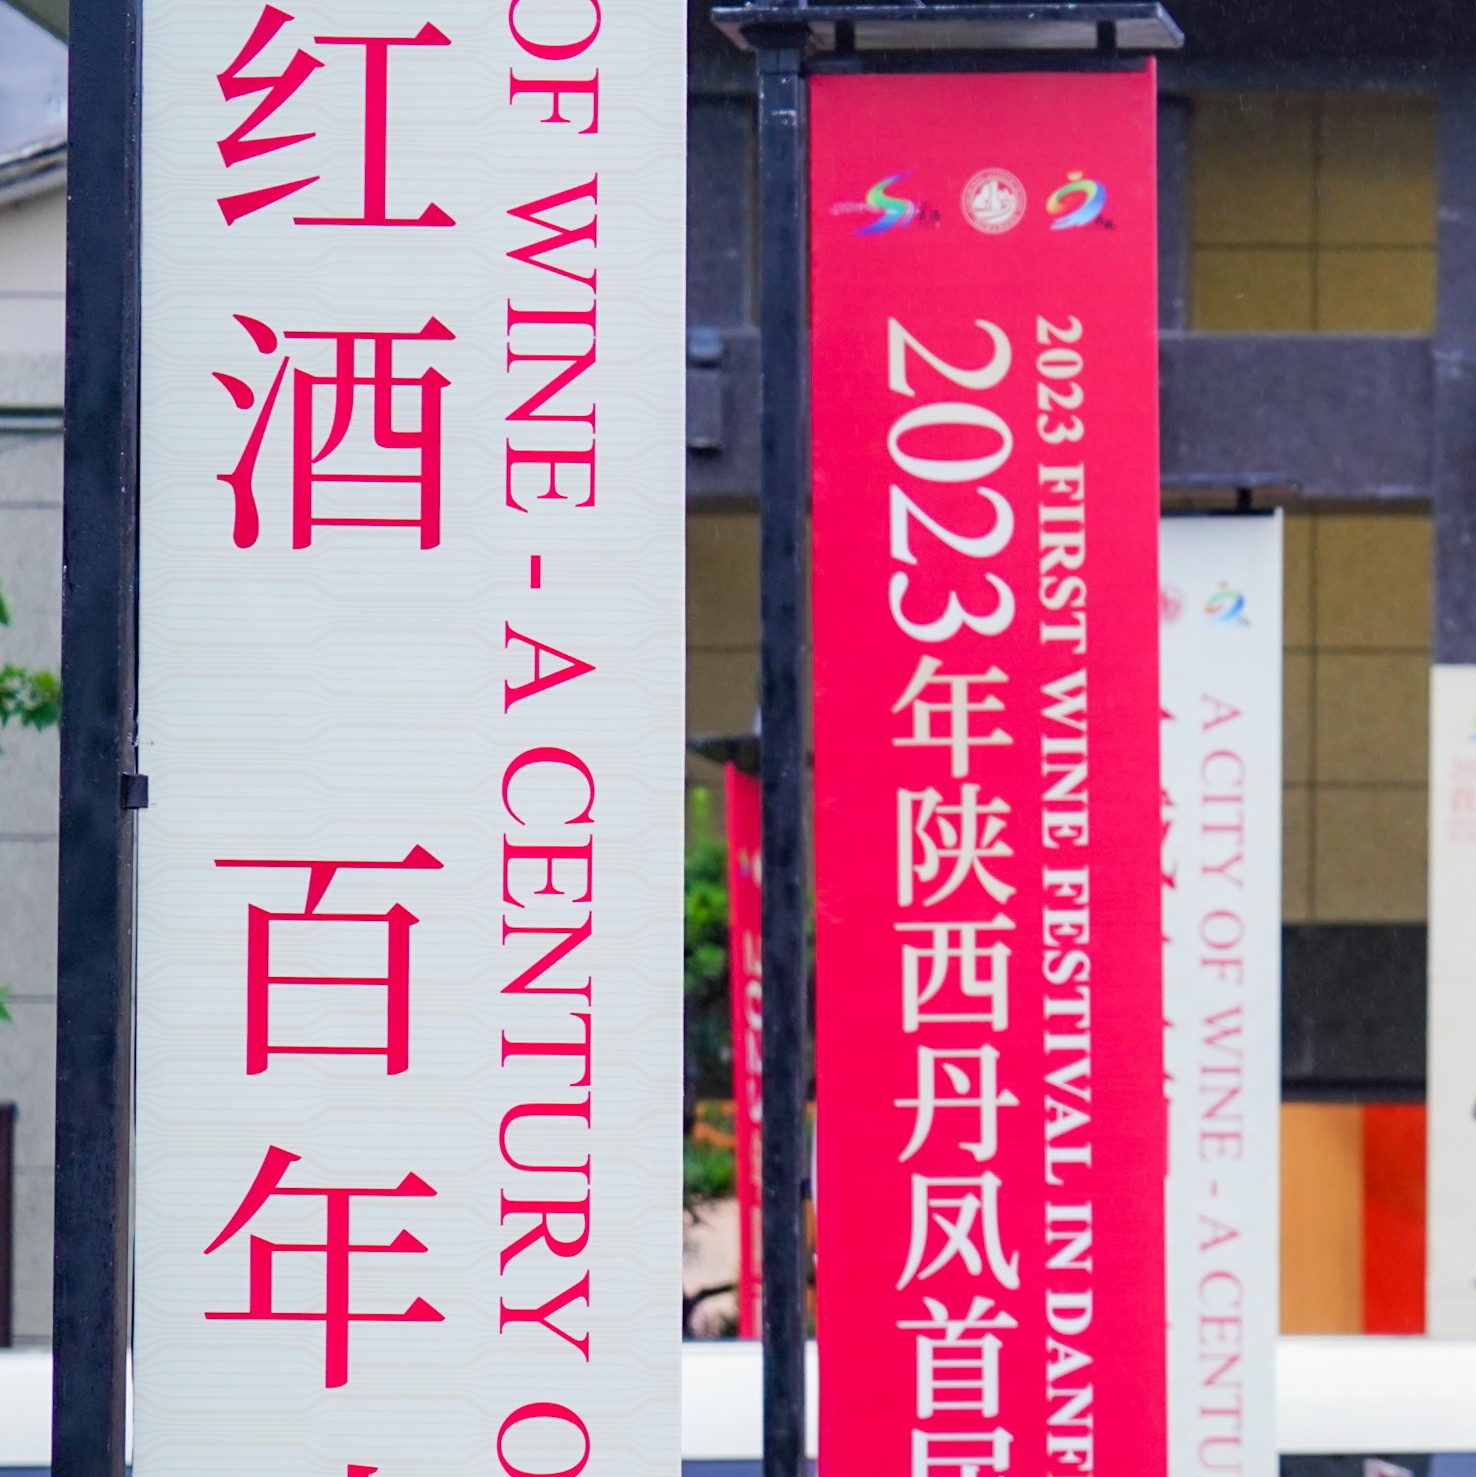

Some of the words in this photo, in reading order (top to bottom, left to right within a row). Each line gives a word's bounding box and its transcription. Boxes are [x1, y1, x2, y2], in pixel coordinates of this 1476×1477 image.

[508, 0, 601, 134] OF
[212, 5, 457, 551] 红酒
[505, 174, 598, 513] WINE
[1037, 316, 1084, 444] 2023
[1039, 465, 1087, 653] FIRST
[503, 621, 596, 713] A
[1200, 694, 1243, 731] A
[1041, 669, 1089, 848] WINE
[1200, 747, 1245, 888] CITY
[1200, 908, 1245, 984] OF
[498, 746, 595, 1361] CENTURY
[1043, 868, 1091, 1185] FESTIVAL
[1199, 1005, 1244, 1163] WINE
[1046, 1203, 1092, 1271] IN
[1199, 1214, 1241, 1253] A
